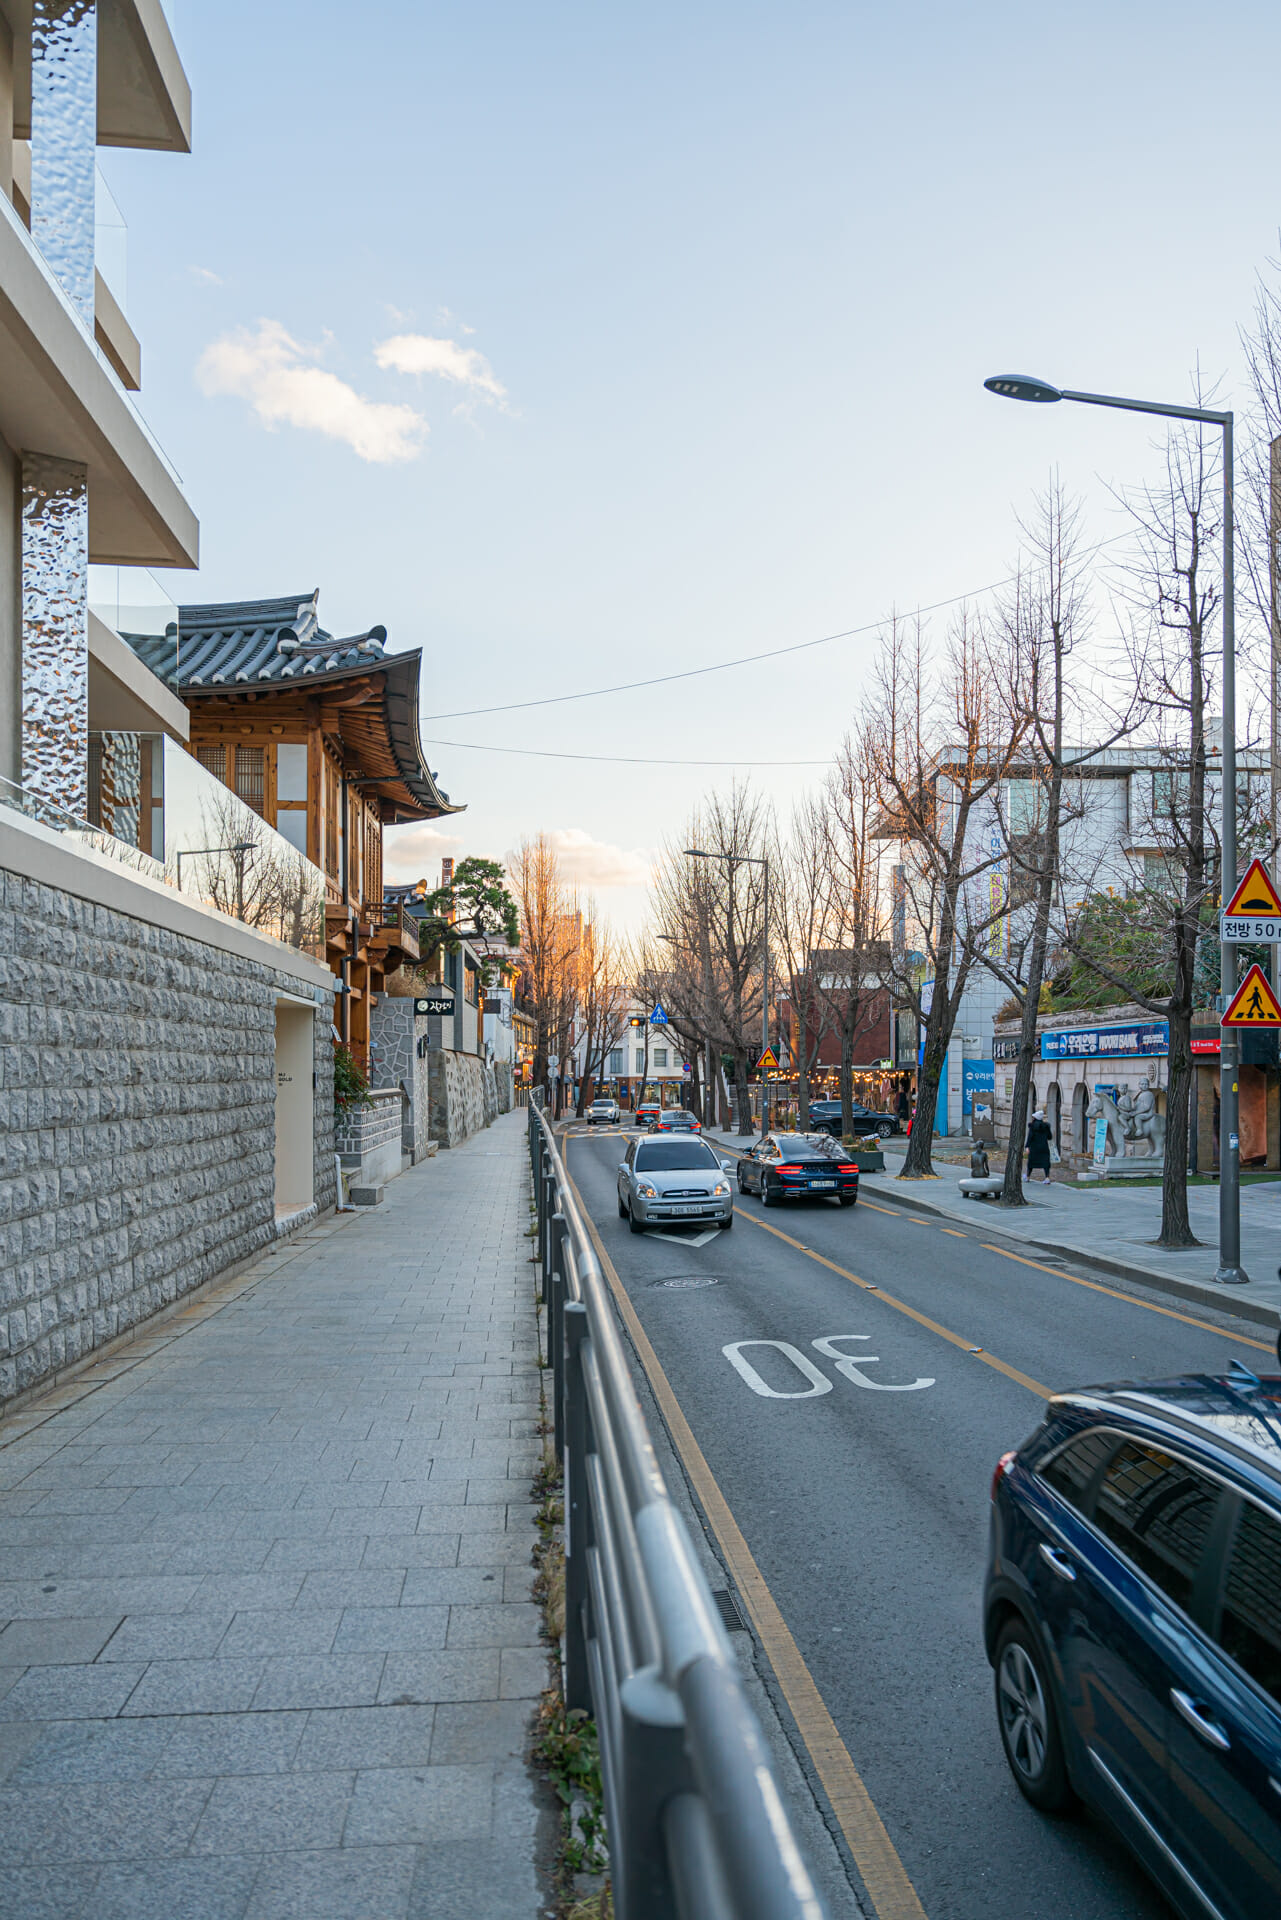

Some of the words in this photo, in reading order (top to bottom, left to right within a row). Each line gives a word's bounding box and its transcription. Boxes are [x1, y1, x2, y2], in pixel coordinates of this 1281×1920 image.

[1225, 922, 1251, 937] 전방
[1255, 923, 1281, 938] 50
[1068, 1033, 1097, 1053] 우리은행
[1119, 1033, 1138, 1048] BANK
[721, 1334, 937, 1399] 30
